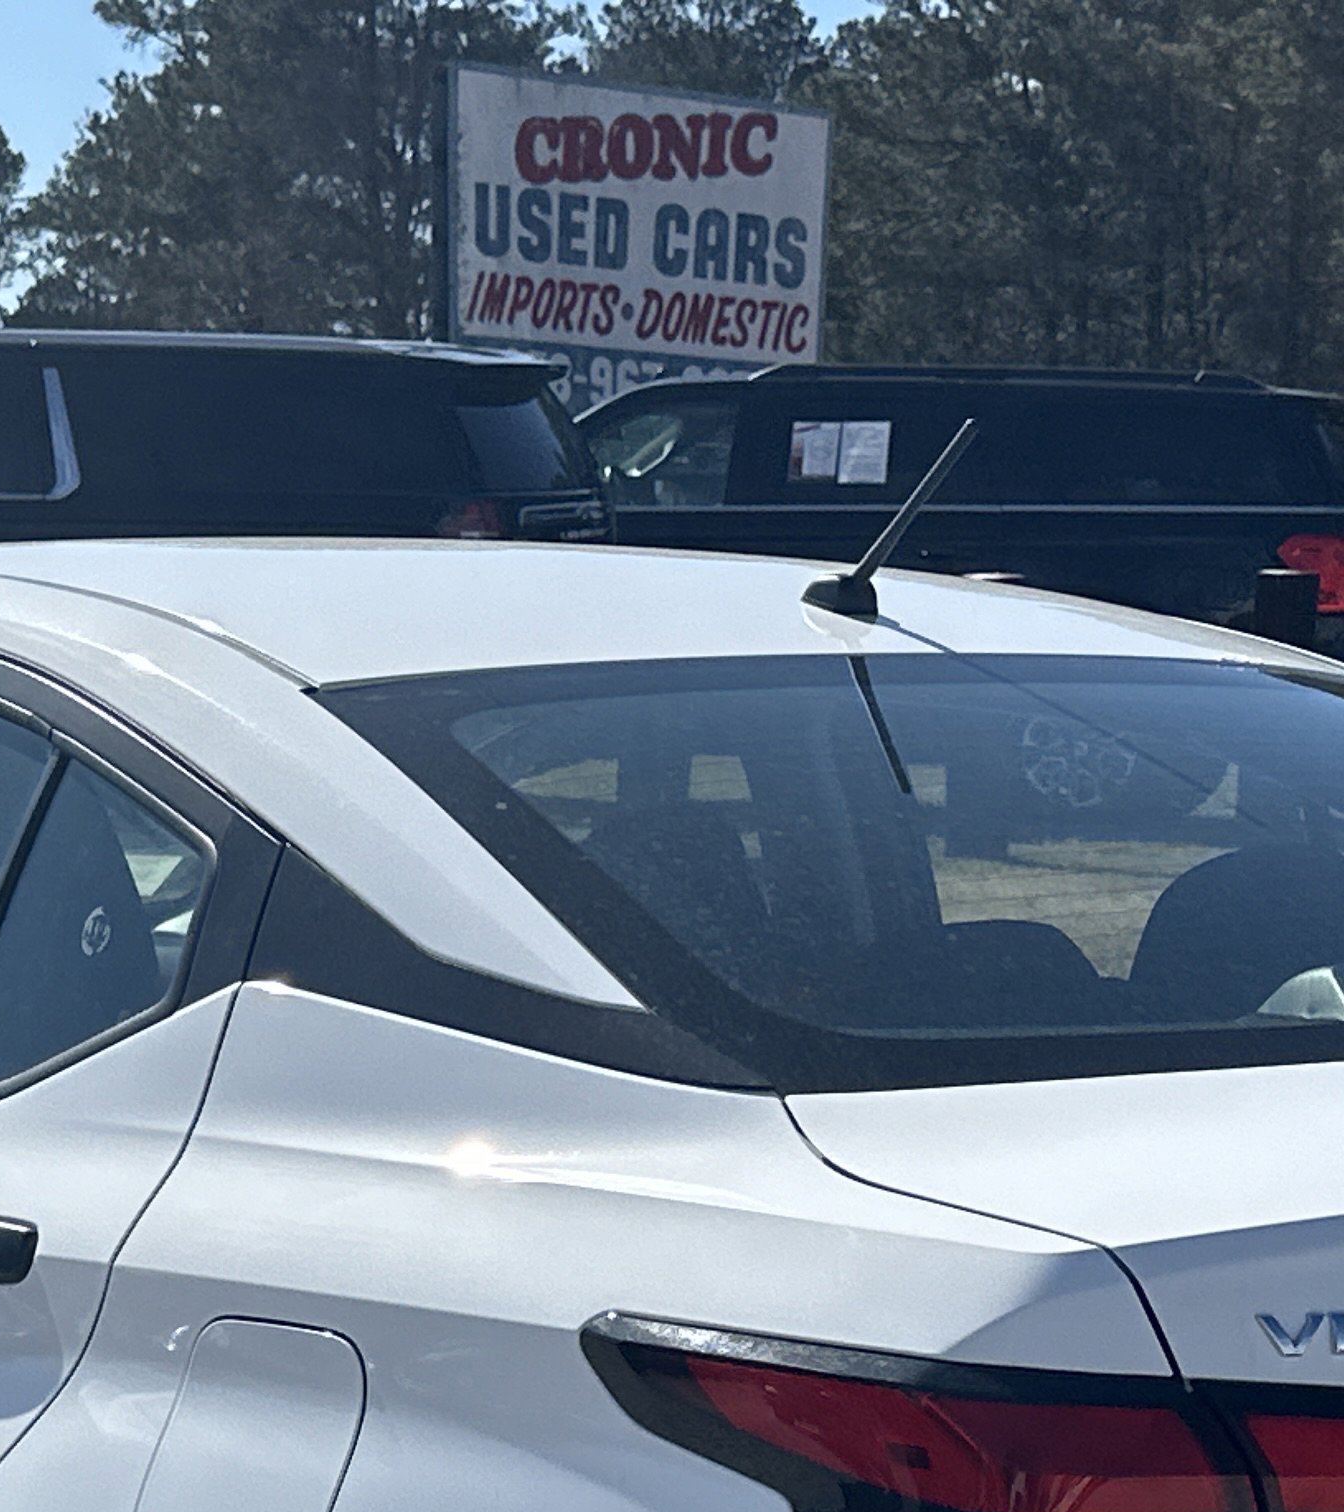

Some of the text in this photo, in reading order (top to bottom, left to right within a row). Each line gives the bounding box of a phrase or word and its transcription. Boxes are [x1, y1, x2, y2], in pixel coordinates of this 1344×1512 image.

[515, 112, 778, 184] CRONIC
[474, 182, 808, 290] USED CARS
[465, 271, 810, 354] IMPORTS DOMESTIC
